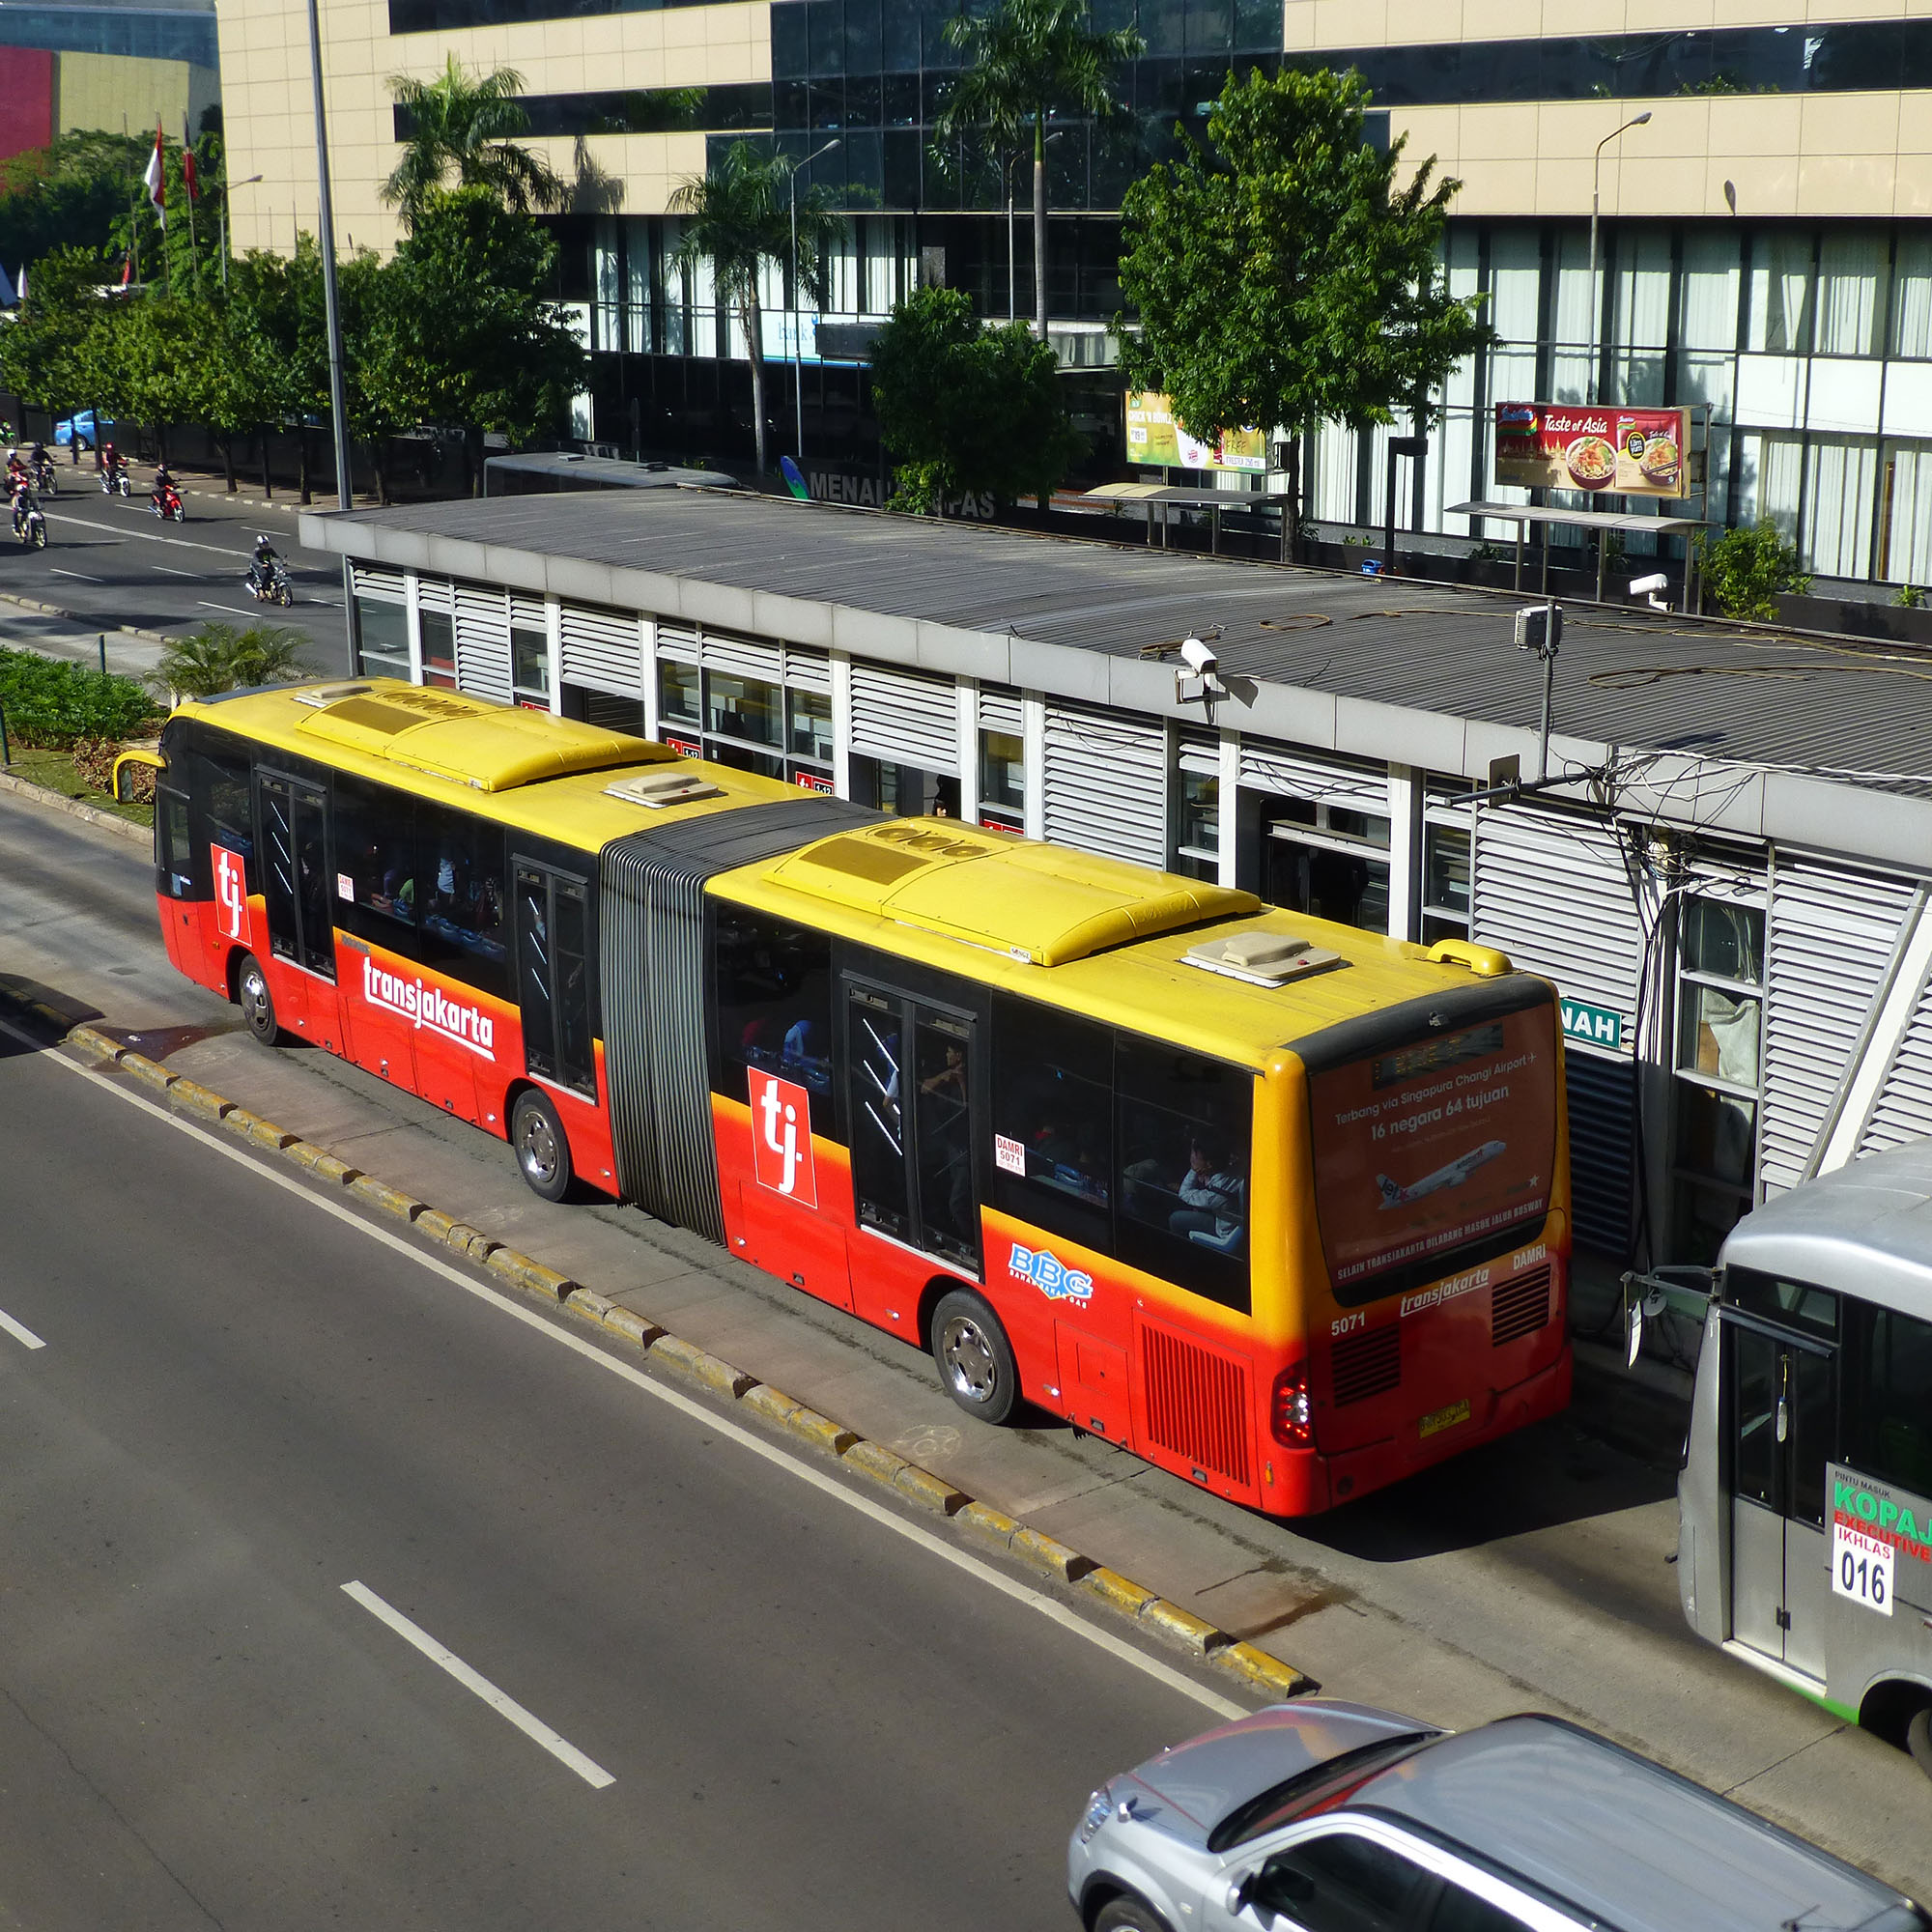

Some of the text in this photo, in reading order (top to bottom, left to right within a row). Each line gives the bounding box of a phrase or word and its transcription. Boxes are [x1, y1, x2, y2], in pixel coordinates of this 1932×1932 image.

[1545, 414, 1571, 433] Taste
[1572, 419, 1583, 432] of
[1582, 417, 1607, 434] Asia
[218, 851, 243, 938] tj
[363, 956, 496, 1062] transjakarta
[1335, 1054, 1527, 1126] Terbang via Singapura Changi Airport
[1371, 1123, 1385, 1141] 16
[1390, 1107, 1442, 1134] negara
[1445, 1099, 1463, 1116] 64
[1466, 1085, 1510, 1110] tujuan
[760, 1079, 803, 1194] tj
[997, 1137, 1023, 1157] DAMRI
[1000, 1150, 1020, 1166] 5071
[1008, 1242, 1094, 1299] BBG
[1513, 1243, 1547, 1271] DAMRI
[1401, 1267, 1490, 1318] transjakarta
[1331, 1311, 1366, 1337] 5071
[1834, 1470, 1890, 1498] PINTU MASUK
[1834, 1509, 1932, 1565] EXECUTIVE
[1838, 1527, 1890, 1560] IKHLAS
[1841, 1550, 1885, 1605] 016
